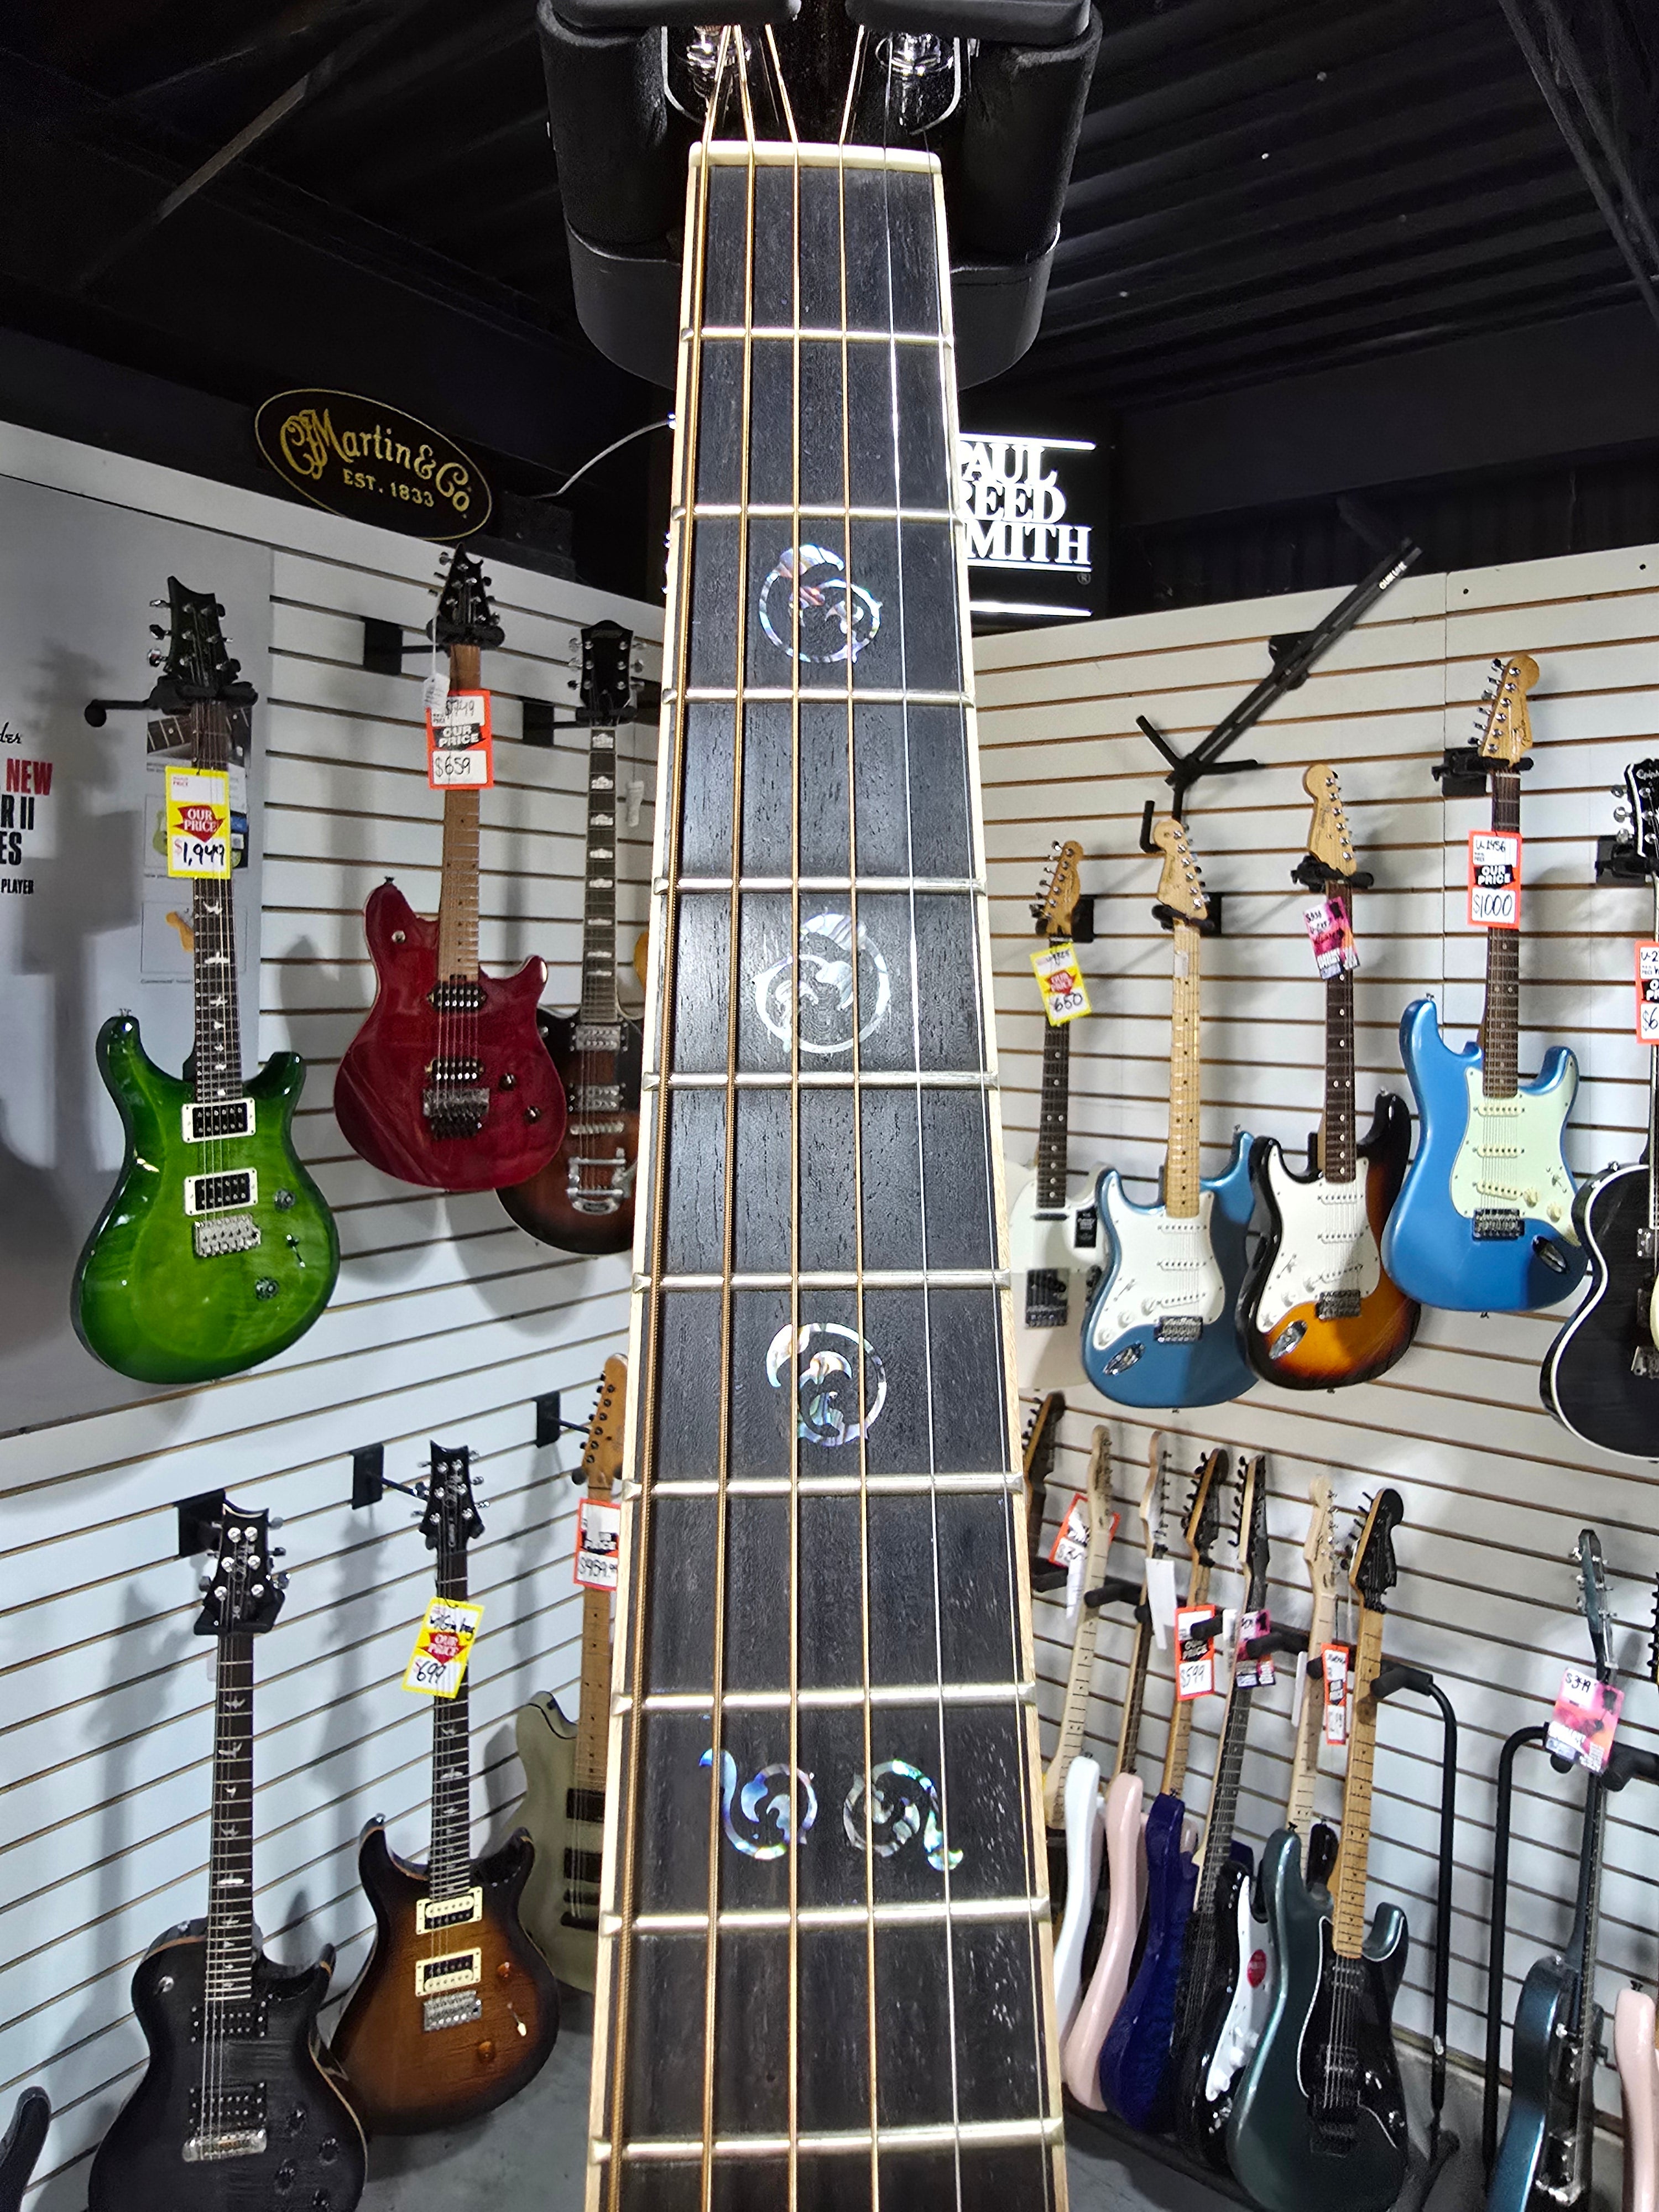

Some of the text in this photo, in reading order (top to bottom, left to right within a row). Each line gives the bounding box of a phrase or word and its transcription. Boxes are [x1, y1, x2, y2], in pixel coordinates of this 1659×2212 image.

[343, 468, 435, 508] EST. 1833
[964, 520, 1092, 565] MITH
[442, 725, 472, 738] OUR
[438, 733, 479, 748] PRICE
[435, 755, 470, 777] $659
[6, 758, 53, 795] NEW
[187, 808, 212, 820] OUR
[1481, 865, 1506, 875] OUR
[1, 878, 34, 895] PLAYER
[1478, 874, 1511, 885] PRICE
